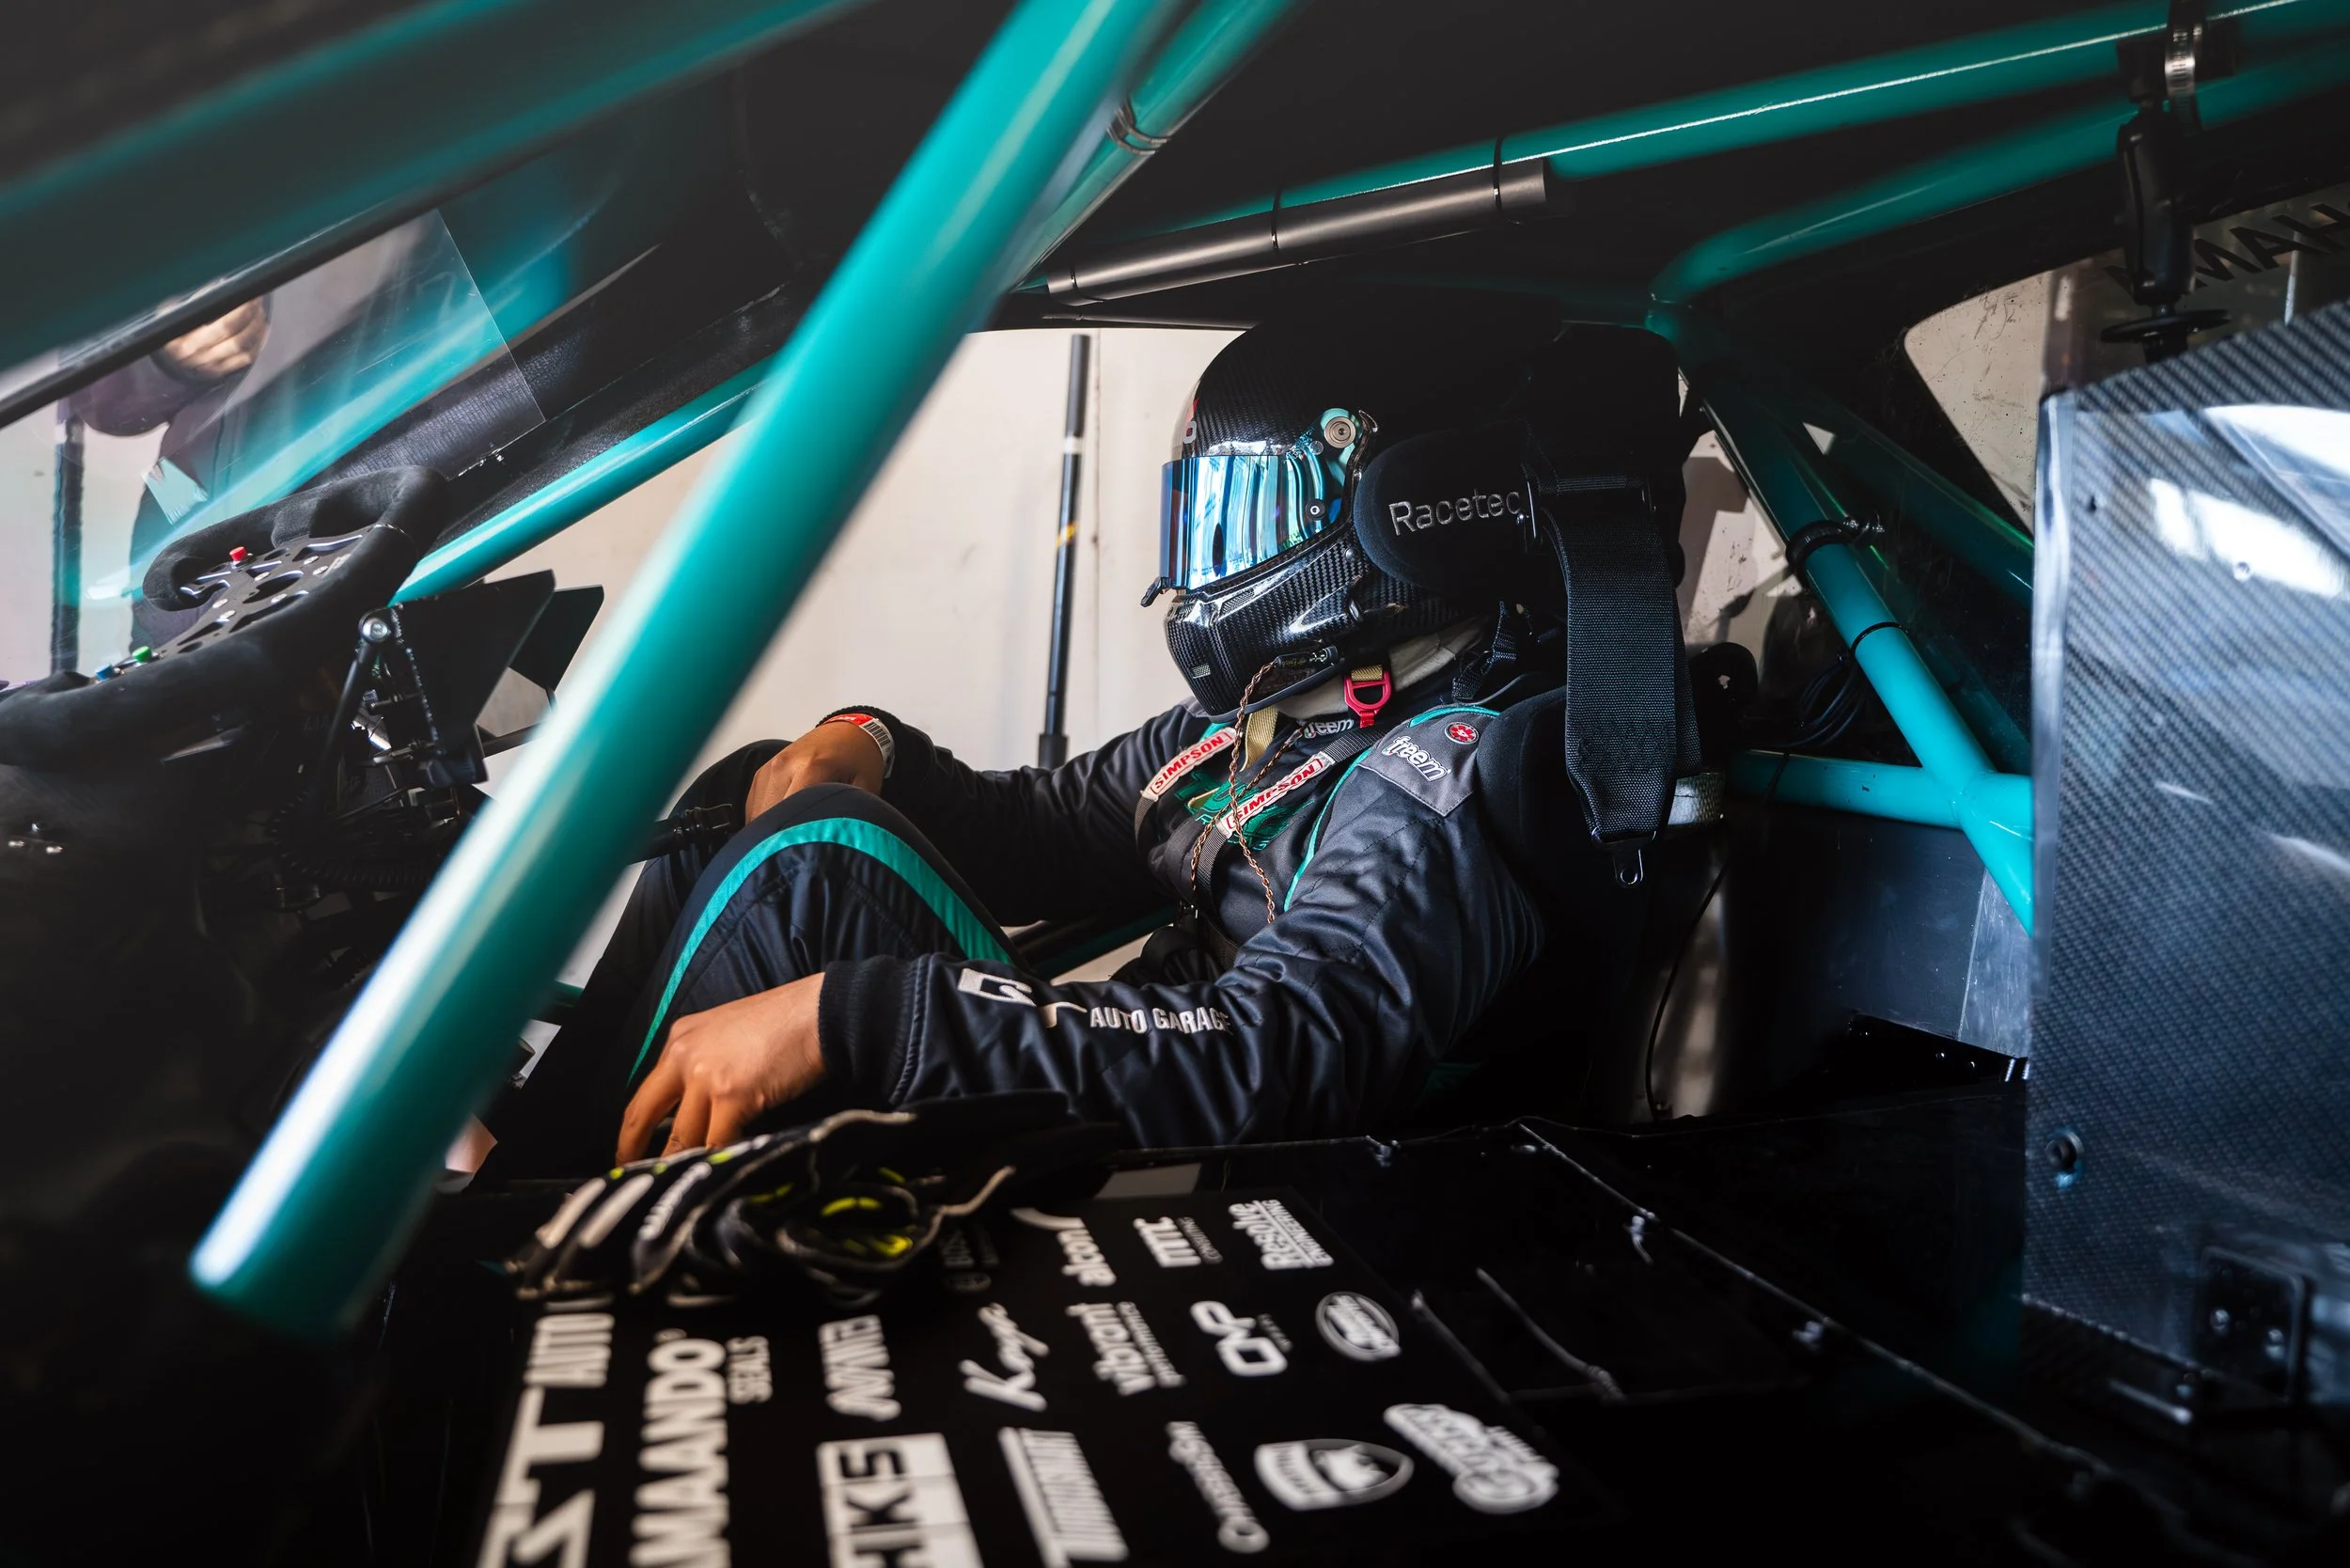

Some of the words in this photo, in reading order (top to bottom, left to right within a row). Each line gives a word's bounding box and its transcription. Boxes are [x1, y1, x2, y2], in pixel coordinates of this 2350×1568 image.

[1150, 733, 1227, 793] SIMPSON
[1382, 736, 1451, 783] freem
[1230, 763, 1318, 823] SIMPSON
[1089, 1006, 1148, 1034] AUTO
[1229, 1200, 1309, 1270] Resolve
[1262, 1199, 1334, 1268] ENGINEERING
[525, 1313, 615, 1388] AUTO
[1067, 1303, 1156, 1395] vibrant
